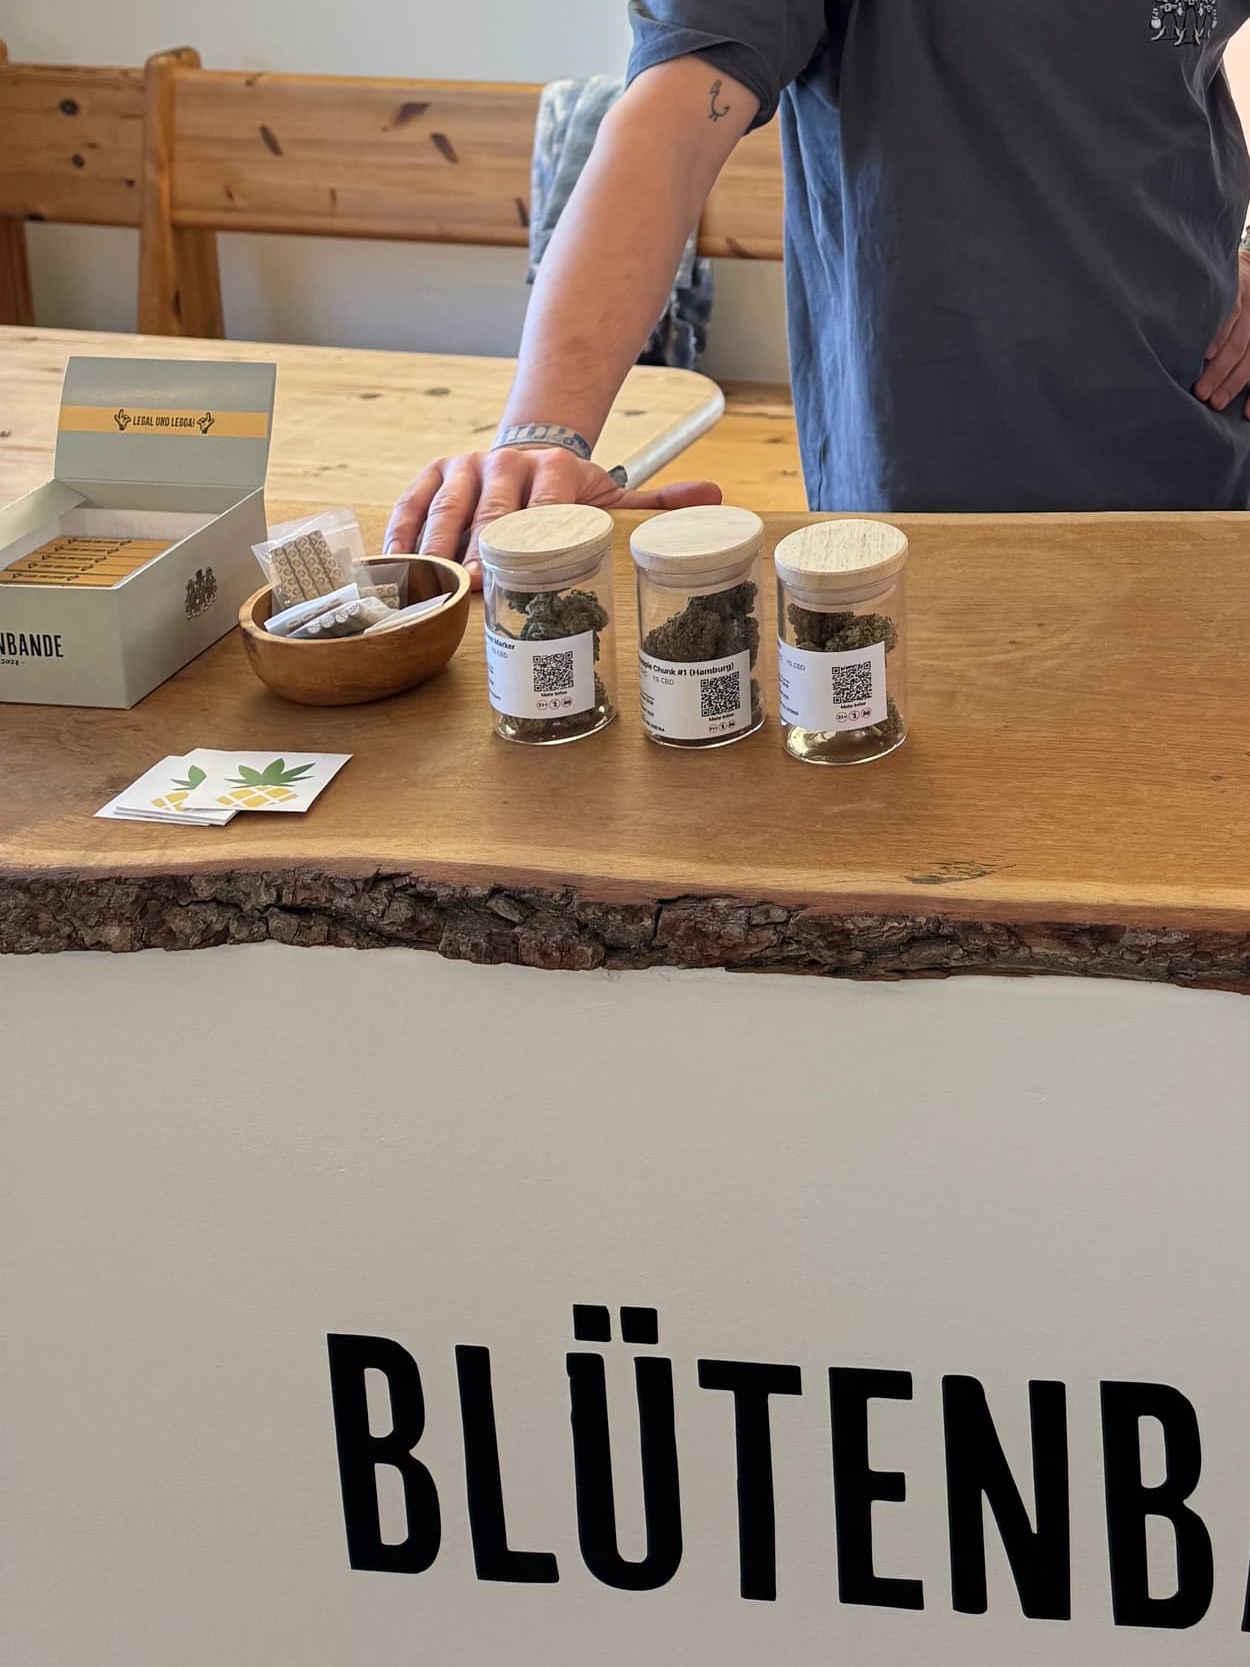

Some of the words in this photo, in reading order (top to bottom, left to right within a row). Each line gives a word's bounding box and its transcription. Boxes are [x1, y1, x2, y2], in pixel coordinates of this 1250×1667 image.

[132, 415, 154, 427] LEGAL
[155, 416, 170, 428] UND
[653, 664, 677, 676] Chunk
